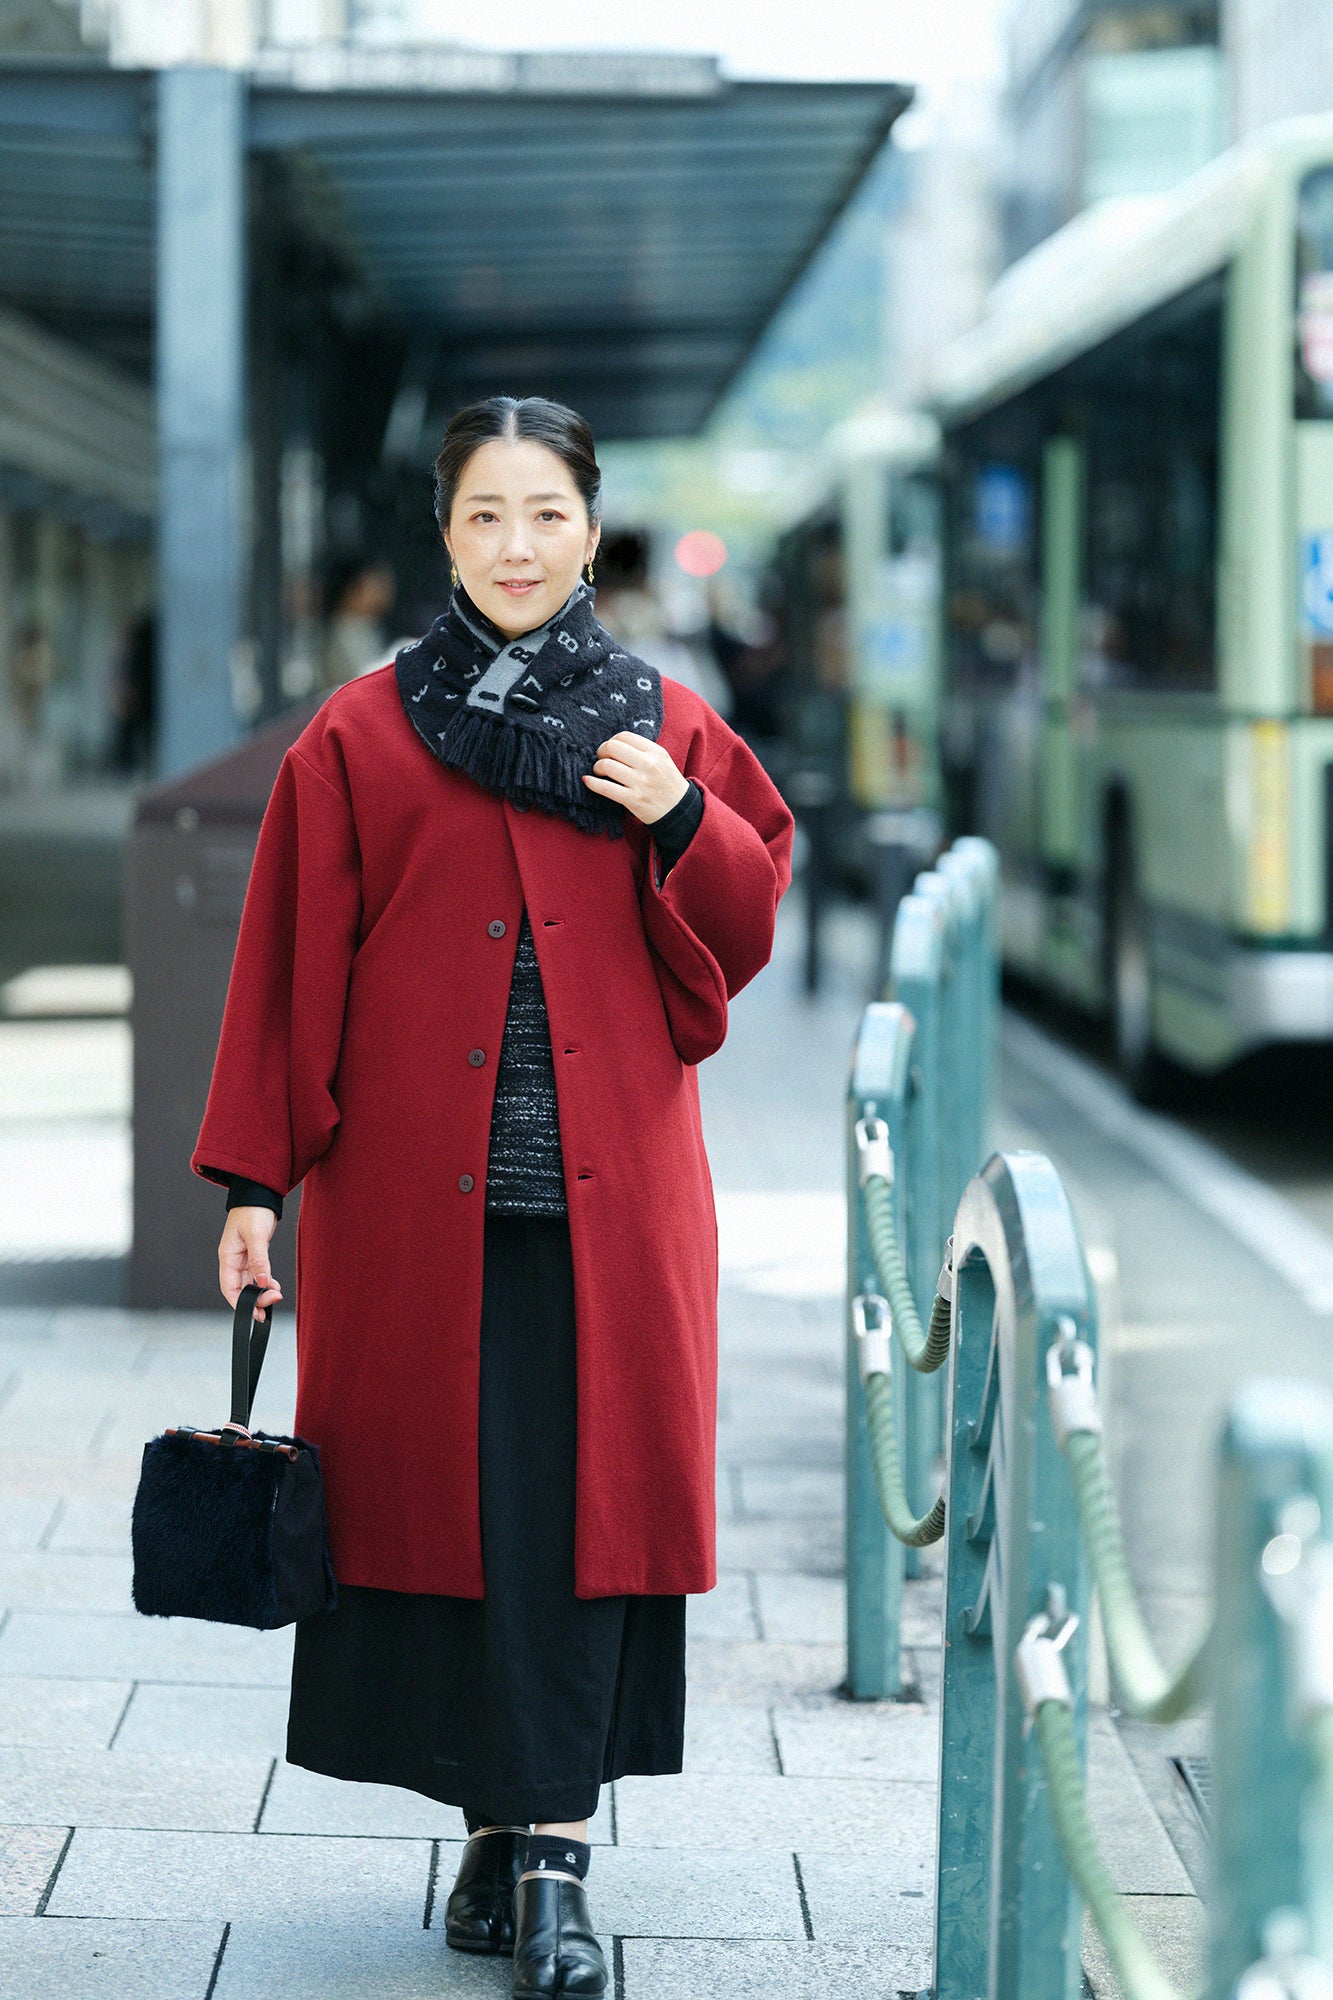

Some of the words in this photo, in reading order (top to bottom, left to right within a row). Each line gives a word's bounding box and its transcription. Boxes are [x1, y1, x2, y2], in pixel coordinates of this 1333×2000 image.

[557, 630, 580, 654] 8
[507, 646, 535, 665] 8
[522, 674, 544, 692] 7
[636, 677, 652, 692] 0
